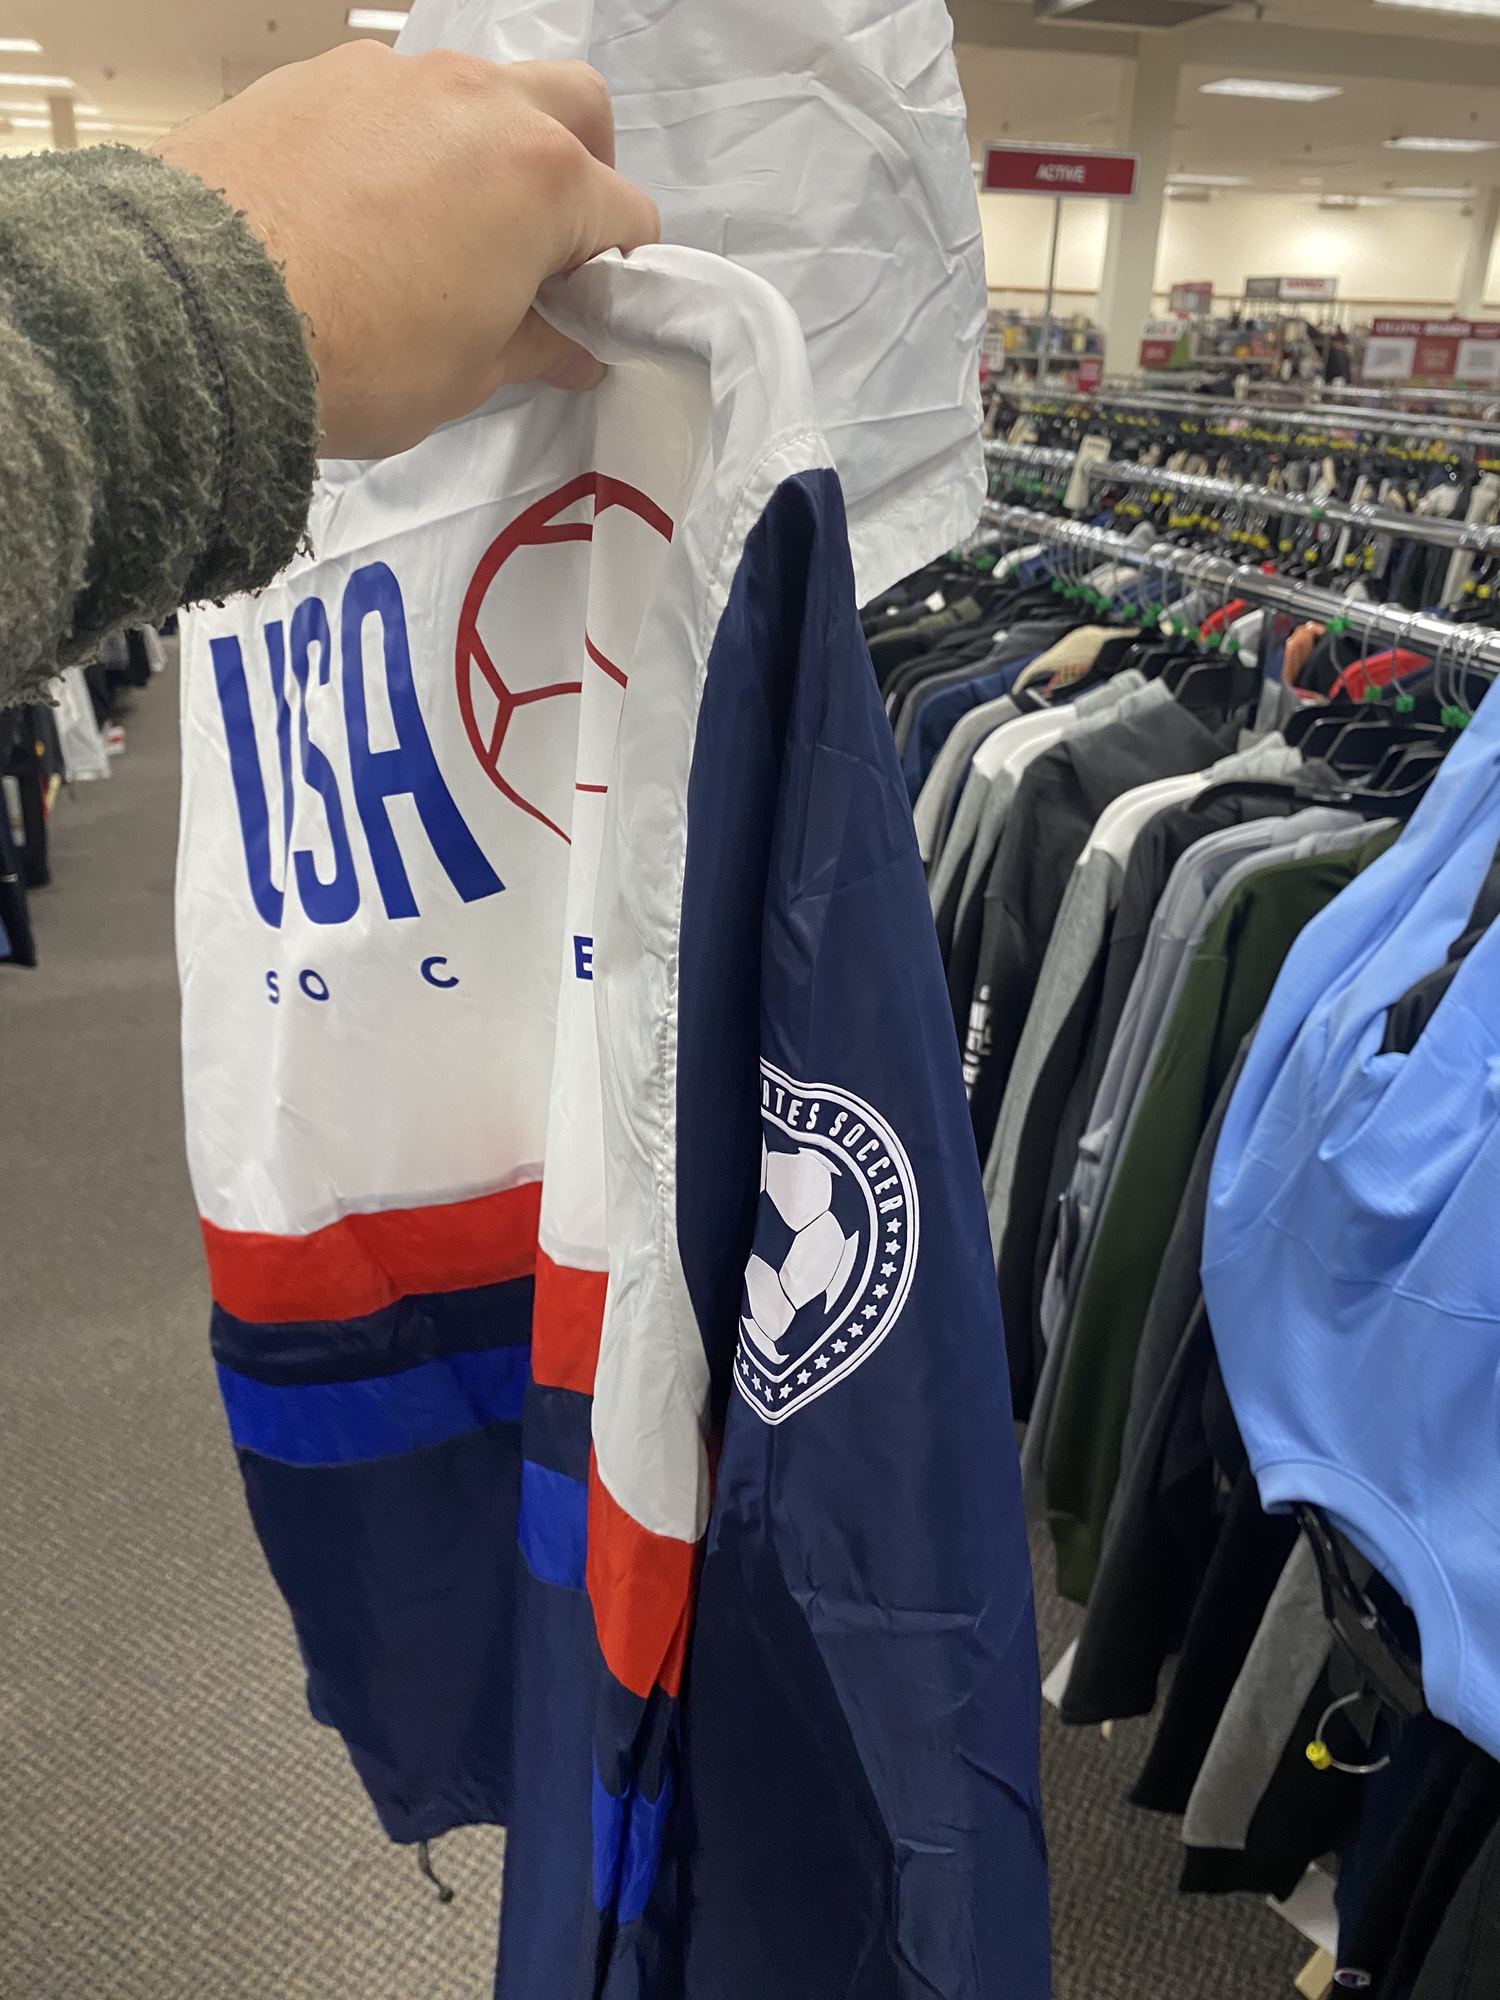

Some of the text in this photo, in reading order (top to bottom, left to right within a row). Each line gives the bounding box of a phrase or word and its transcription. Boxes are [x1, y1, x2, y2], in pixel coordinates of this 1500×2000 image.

[1035, 163, 1086, 184] ACTIVE
[208, 560, 506, 929] USA
[762, 1079, 904, 1214] ATES SOCCER
